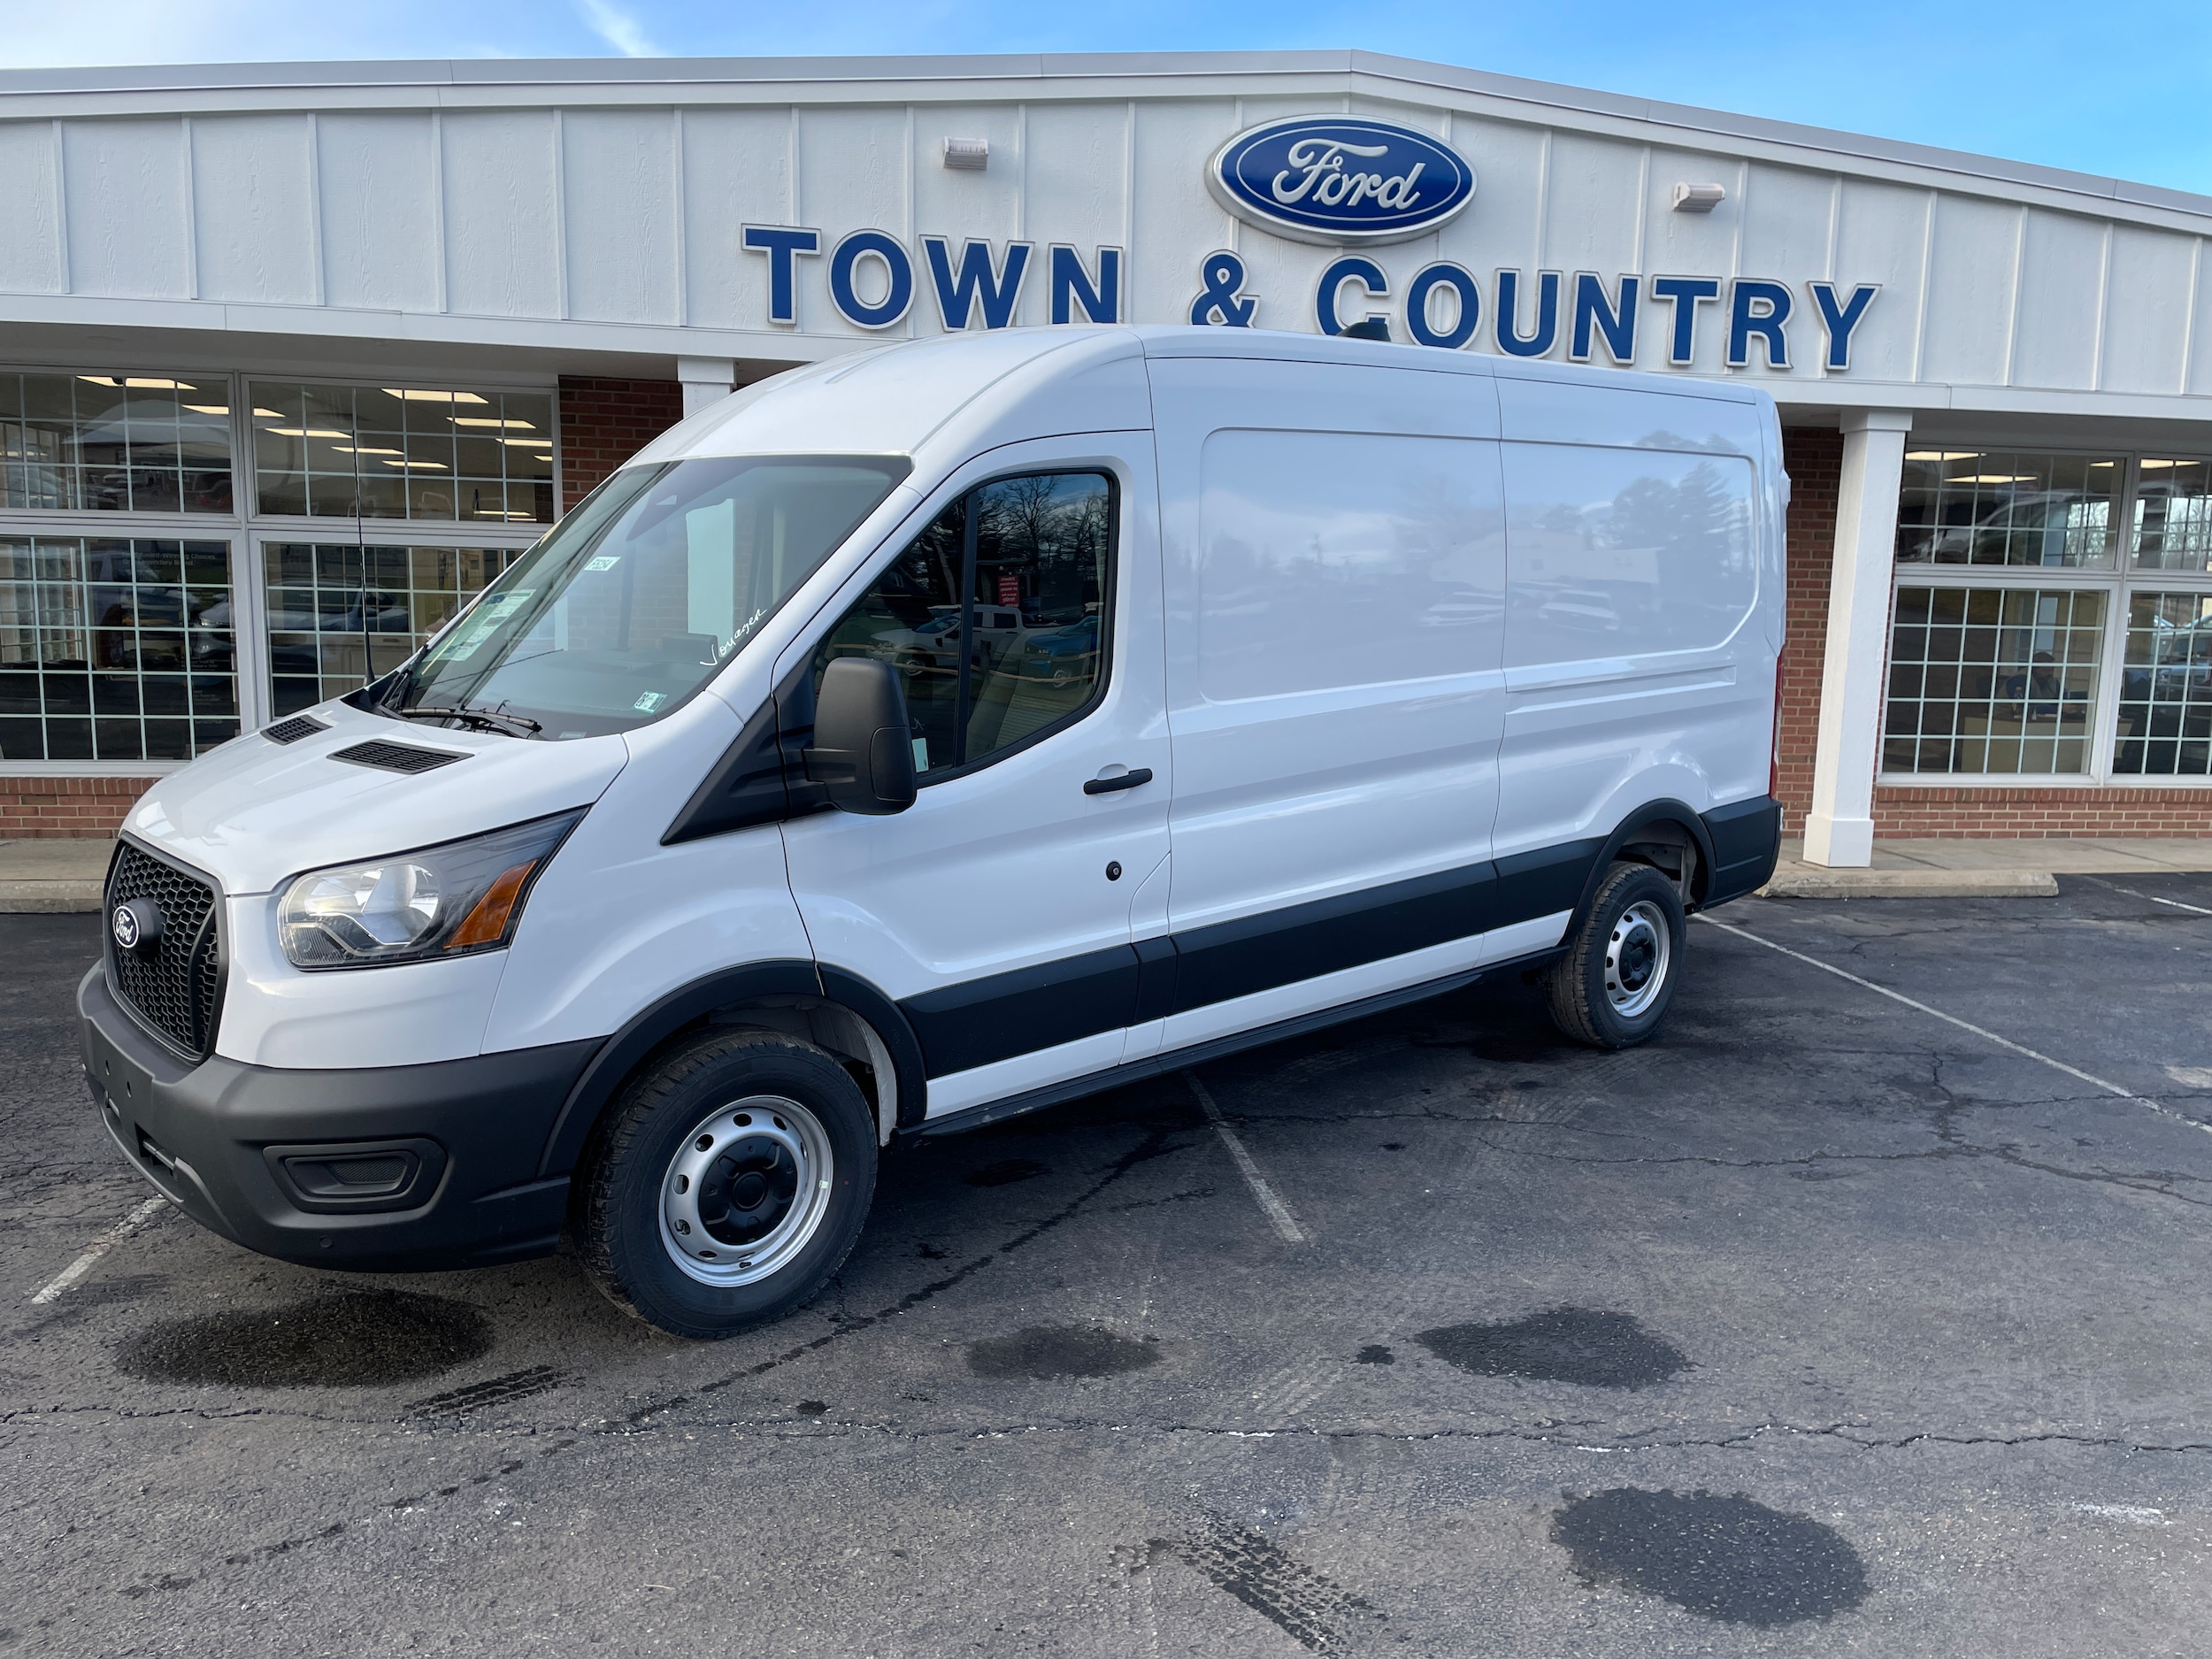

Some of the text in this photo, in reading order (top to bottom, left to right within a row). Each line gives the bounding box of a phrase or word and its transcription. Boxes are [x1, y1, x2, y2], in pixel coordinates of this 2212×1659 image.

[1271, 137, 1426, 211] Ford
[741, 223, 1882, 371] TOWN & COUNTRY
[115, 910, 134, 943] Ford
